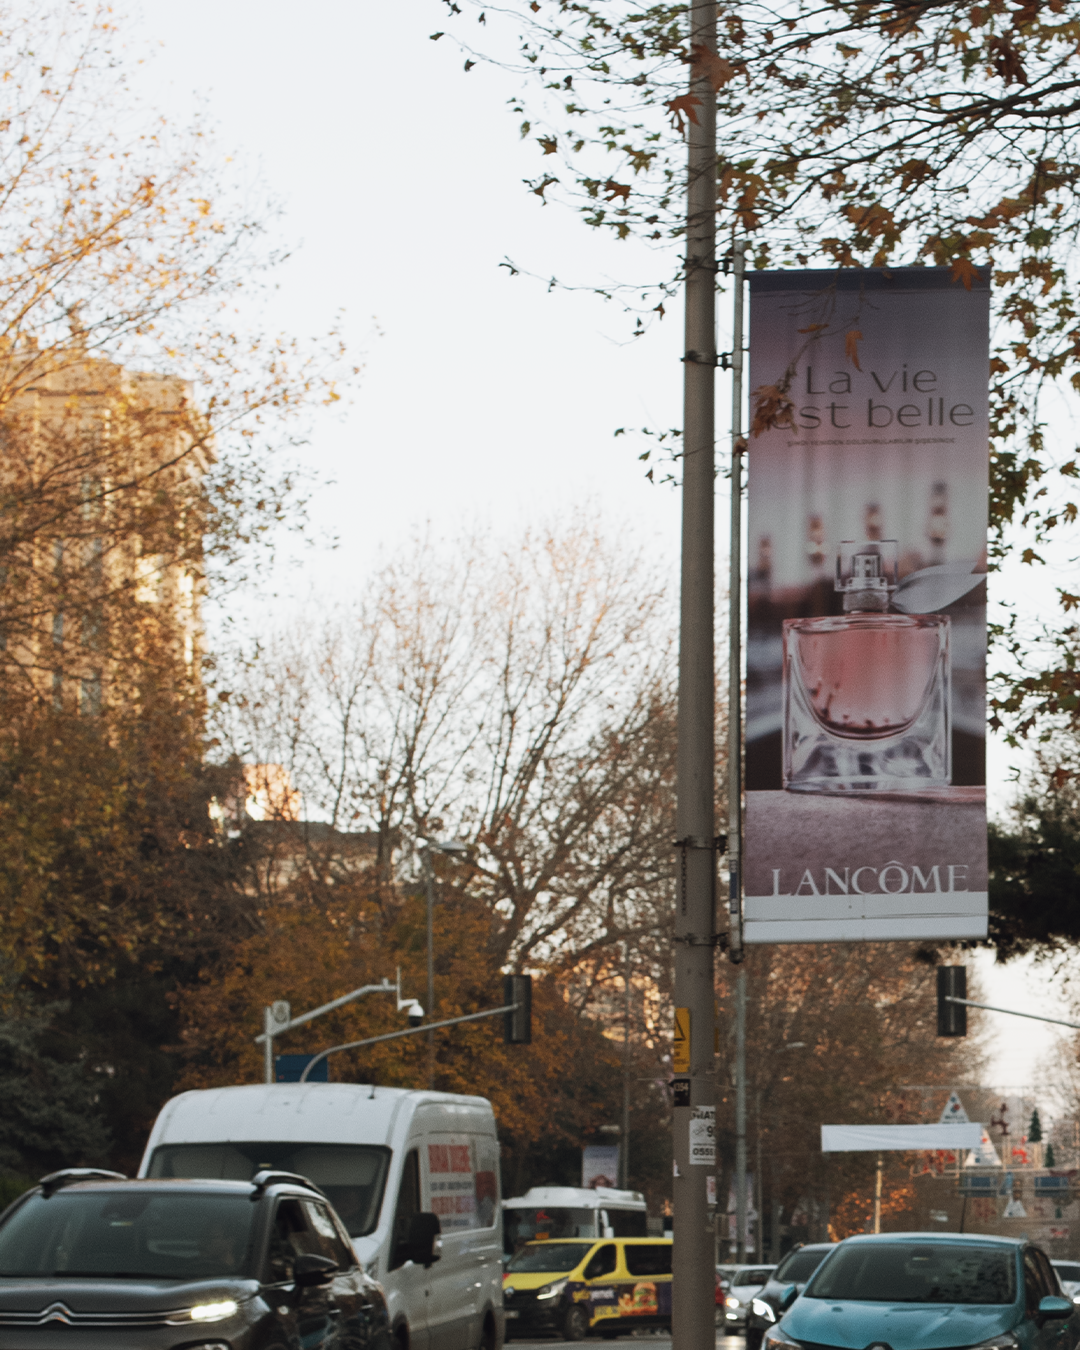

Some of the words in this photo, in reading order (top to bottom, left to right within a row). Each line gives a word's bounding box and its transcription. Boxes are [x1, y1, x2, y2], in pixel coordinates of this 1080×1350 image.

[806, 366, 852, 395] La
[870, 364, 938, 393] vie
[867, 397, 974, 428] belle
[771, 860, 970, 896] LANCÔME
[692, 1147, 716, 1157] 0555
